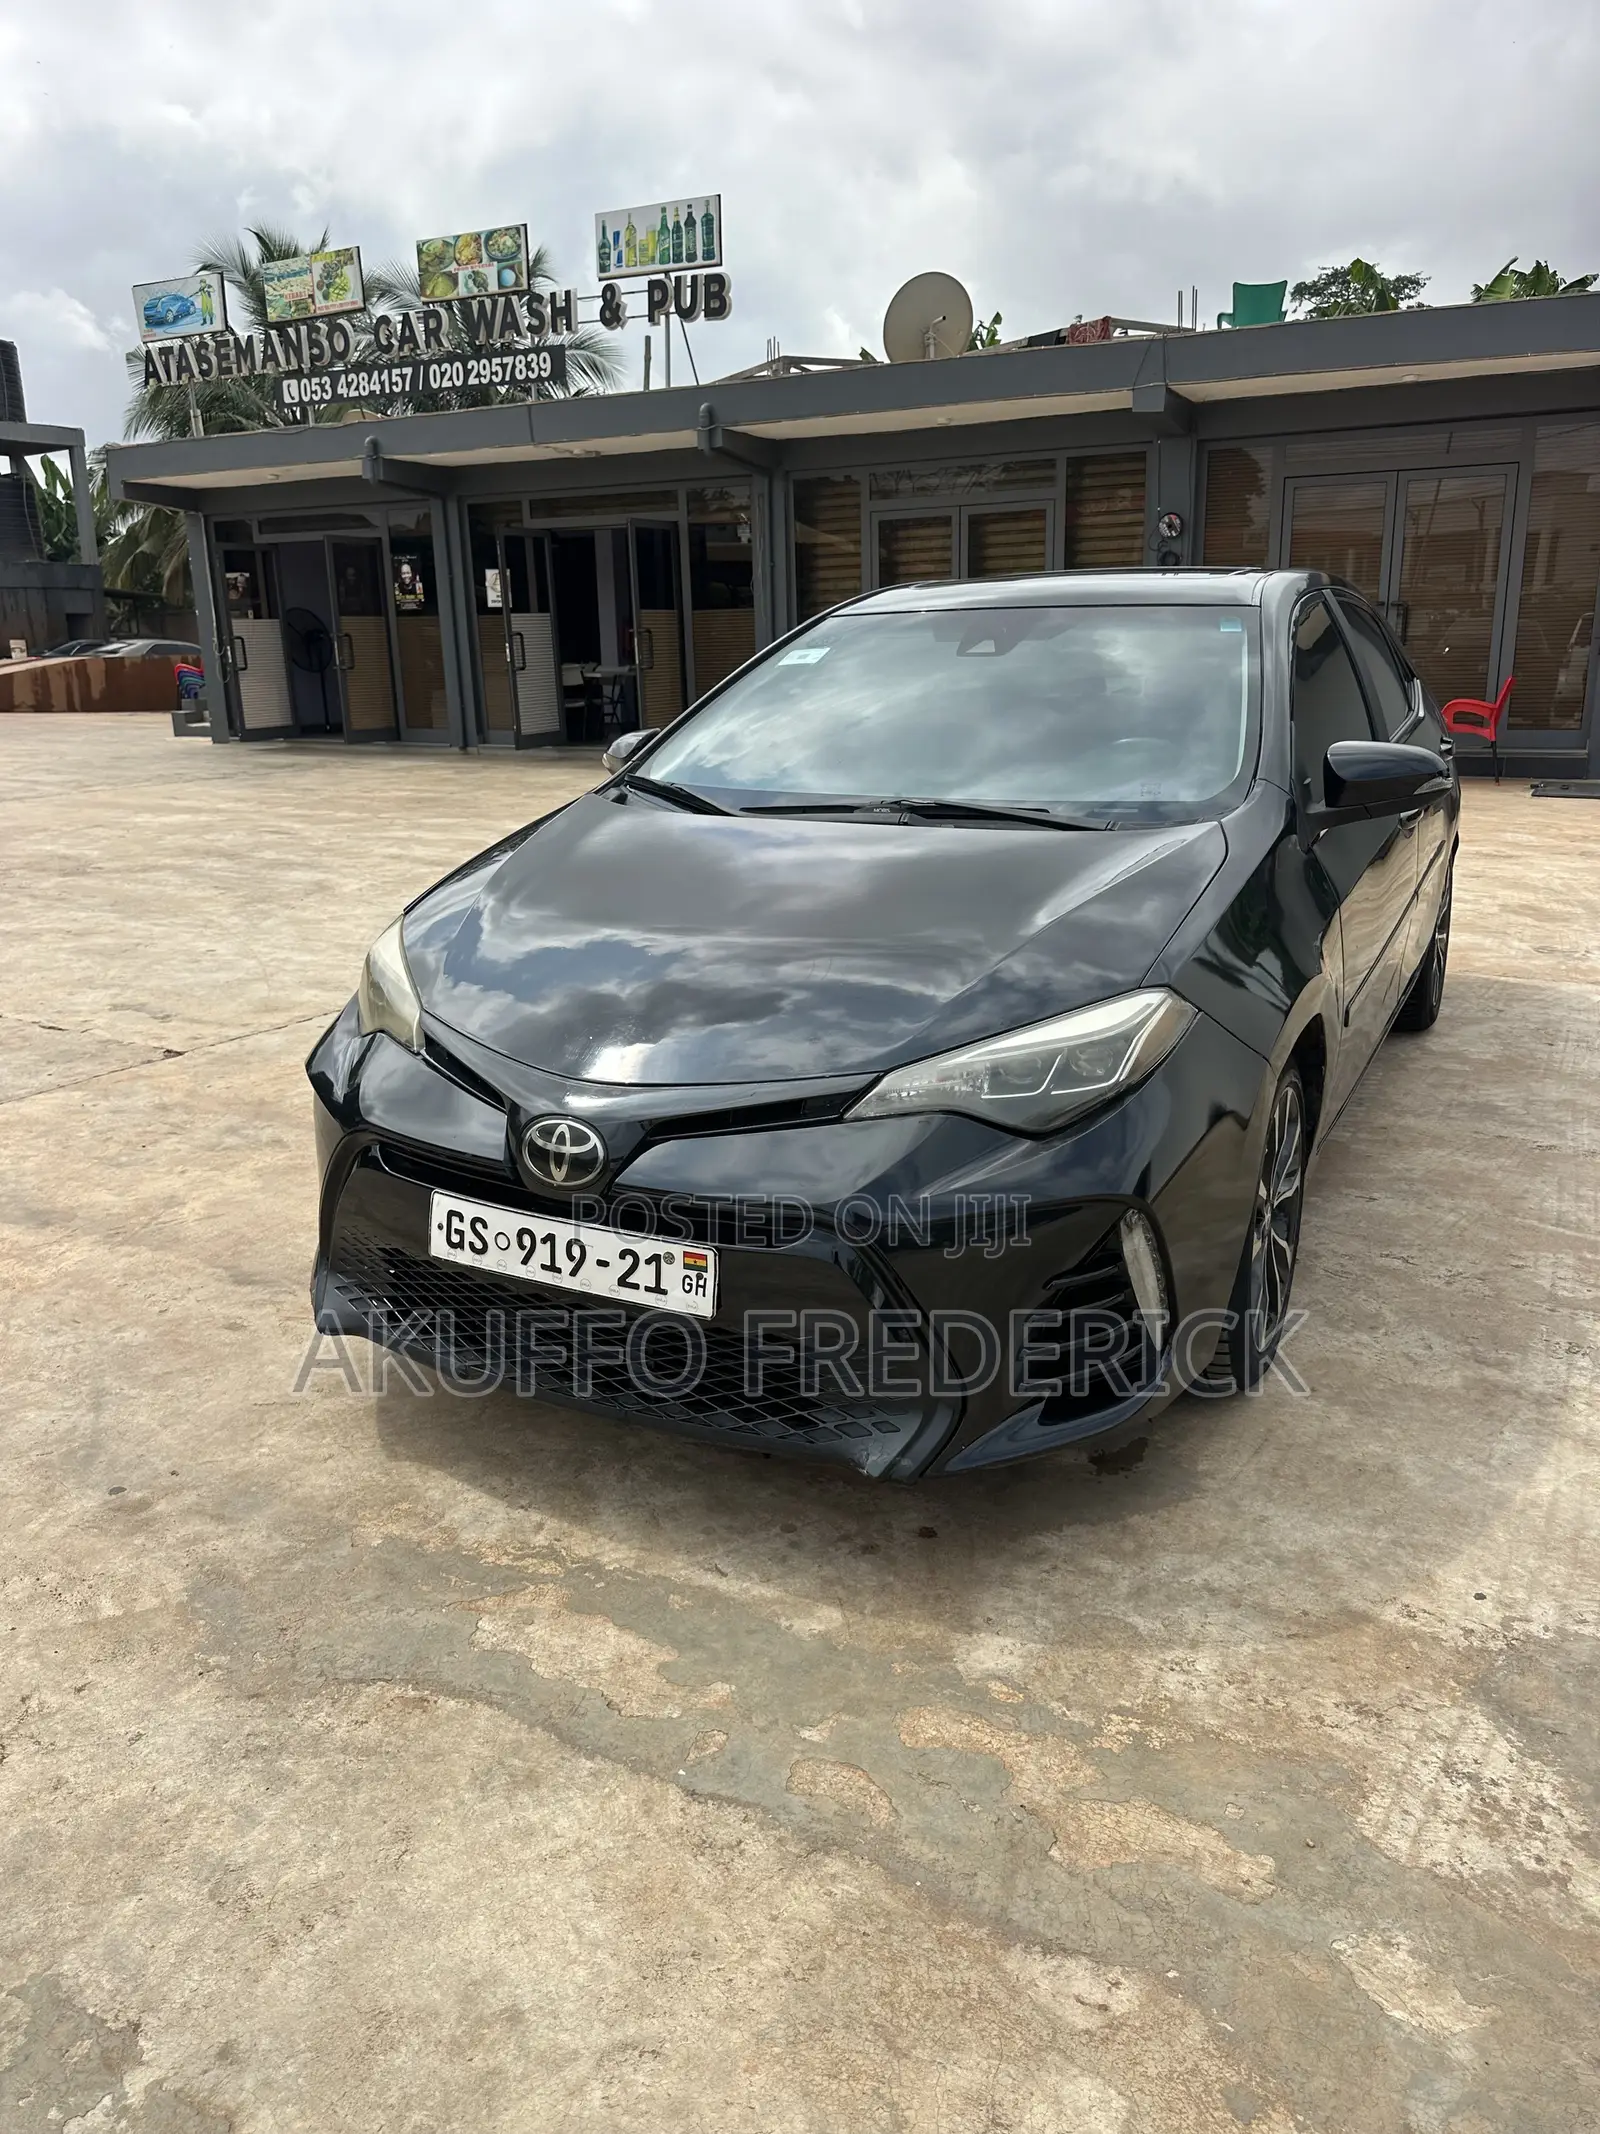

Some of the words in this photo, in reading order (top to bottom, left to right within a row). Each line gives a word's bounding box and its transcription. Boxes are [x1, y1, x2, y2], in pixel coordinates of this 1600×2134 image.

[144, 318, 354, 387] ATASEMANSO
[374, 307, 450, 359] CAR
[469, 287, 578, 346] WASH
[599, 282, 628, 331] &
[647, 272, 732, 327] PUB
[300, 376, 332, 402] 053
[336, 367, 413, 398] 4284157
[428, 361, 464, 390] 020
[467, 352, 552, 386] 2957839
[445, 1209, 489, 1256] GS
[516, 1226, 668, 1296] 919-21
[682, 1274, 707, 1298] GH
